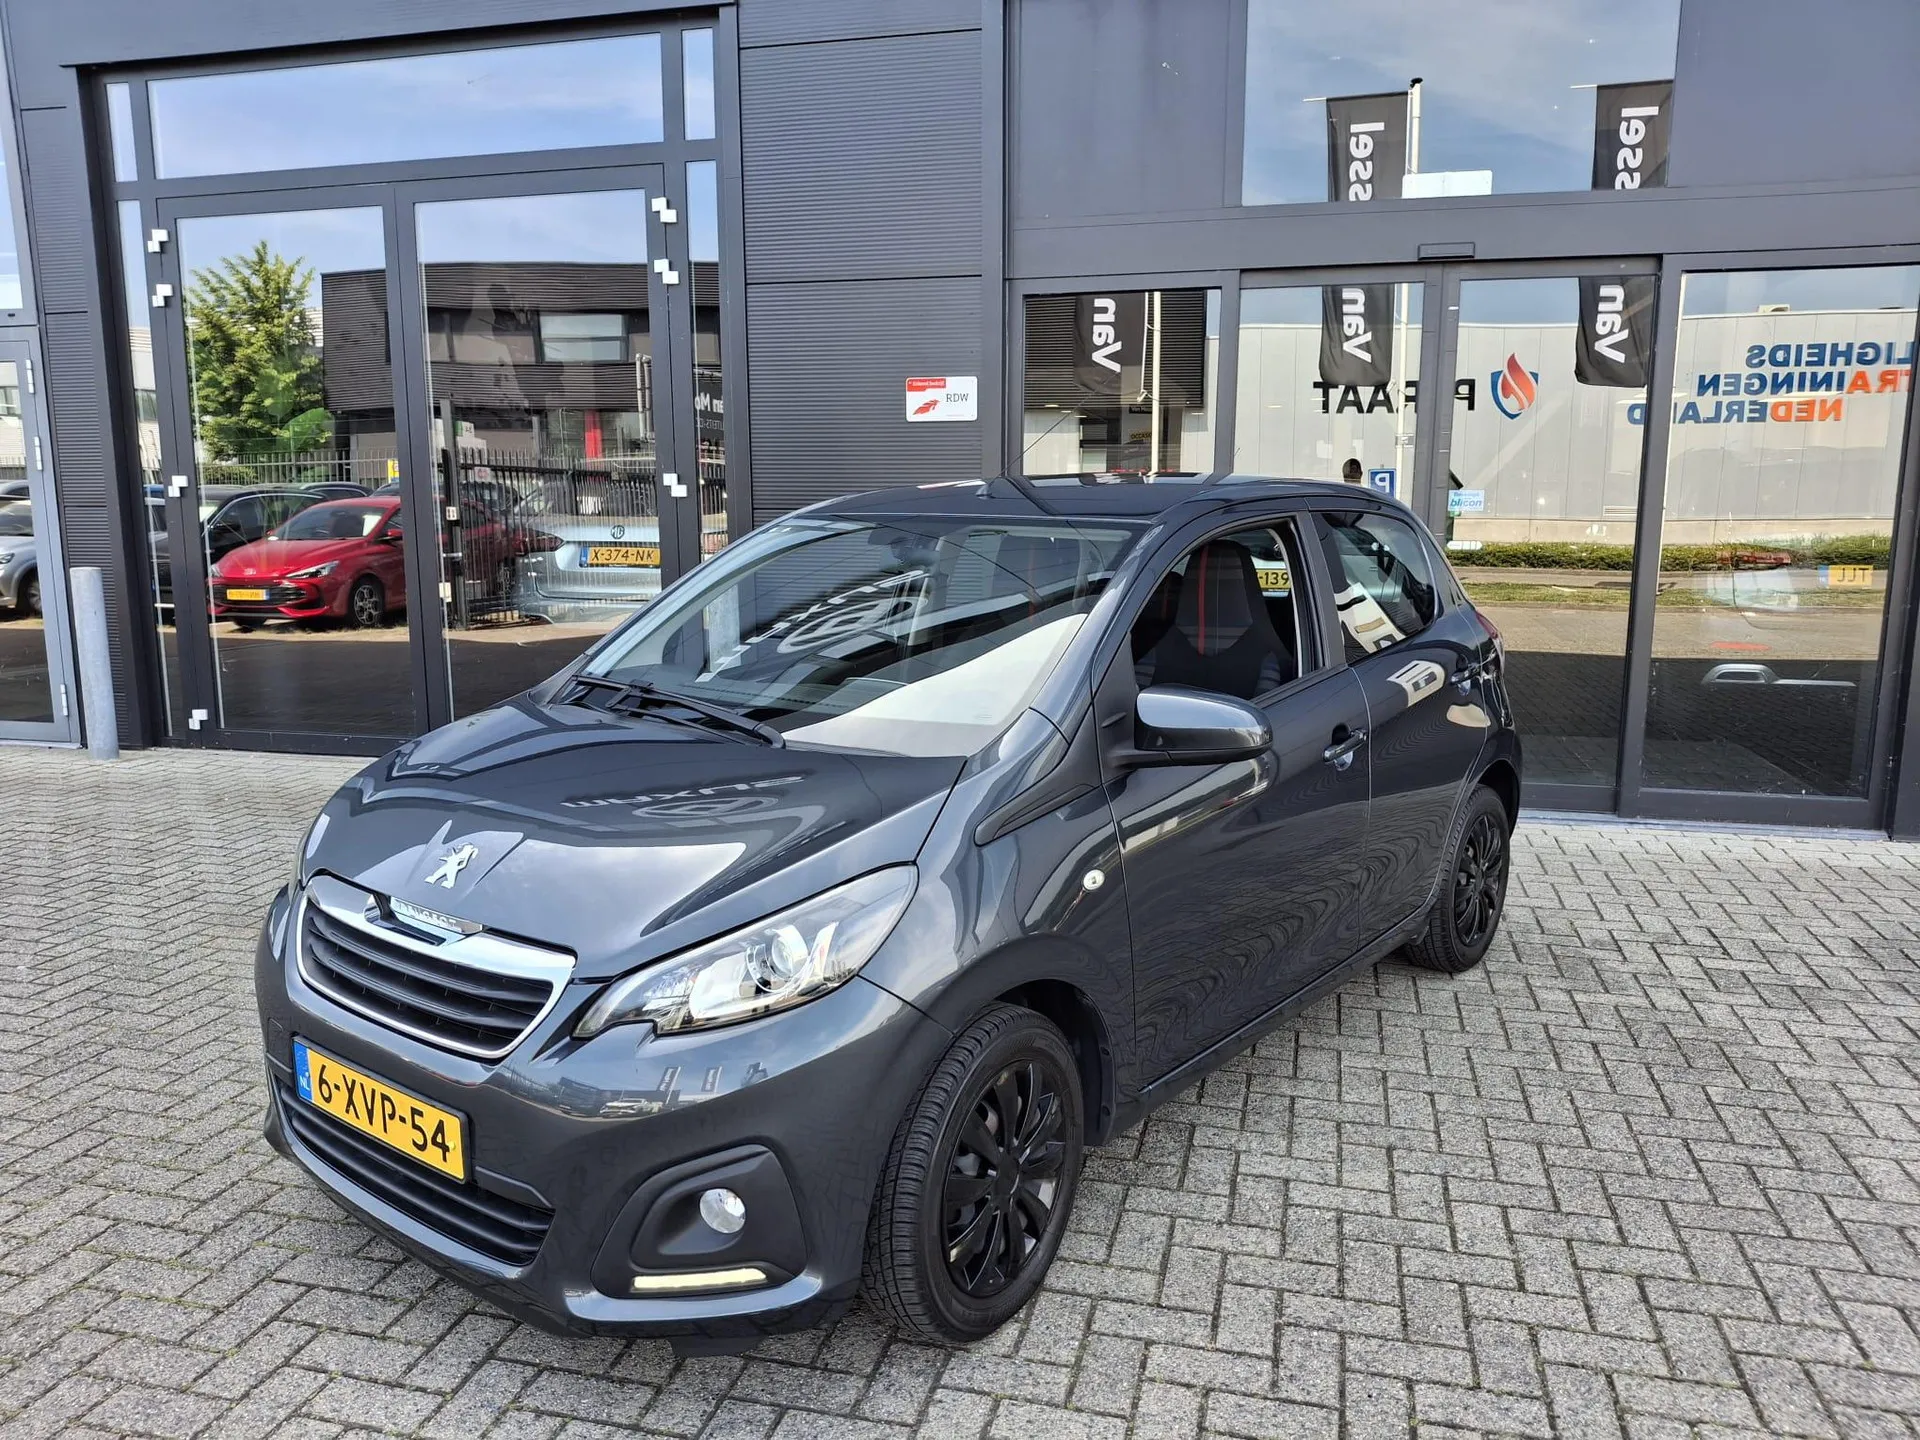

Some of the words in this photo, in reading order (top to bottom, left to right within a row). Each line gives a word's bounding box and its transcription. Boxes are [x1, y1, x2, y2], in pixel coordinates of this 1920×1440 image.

[946, 393, 969, 402] RDW
[1450, 499, 1482, 507] blicon
[592, 549, 654, 562] X-374-NK
[1259, 572, 1289, 585] -139
[299, 1075, 311, 1092] NL
[318, 1063, 450, 1163] 6-XVP-54
